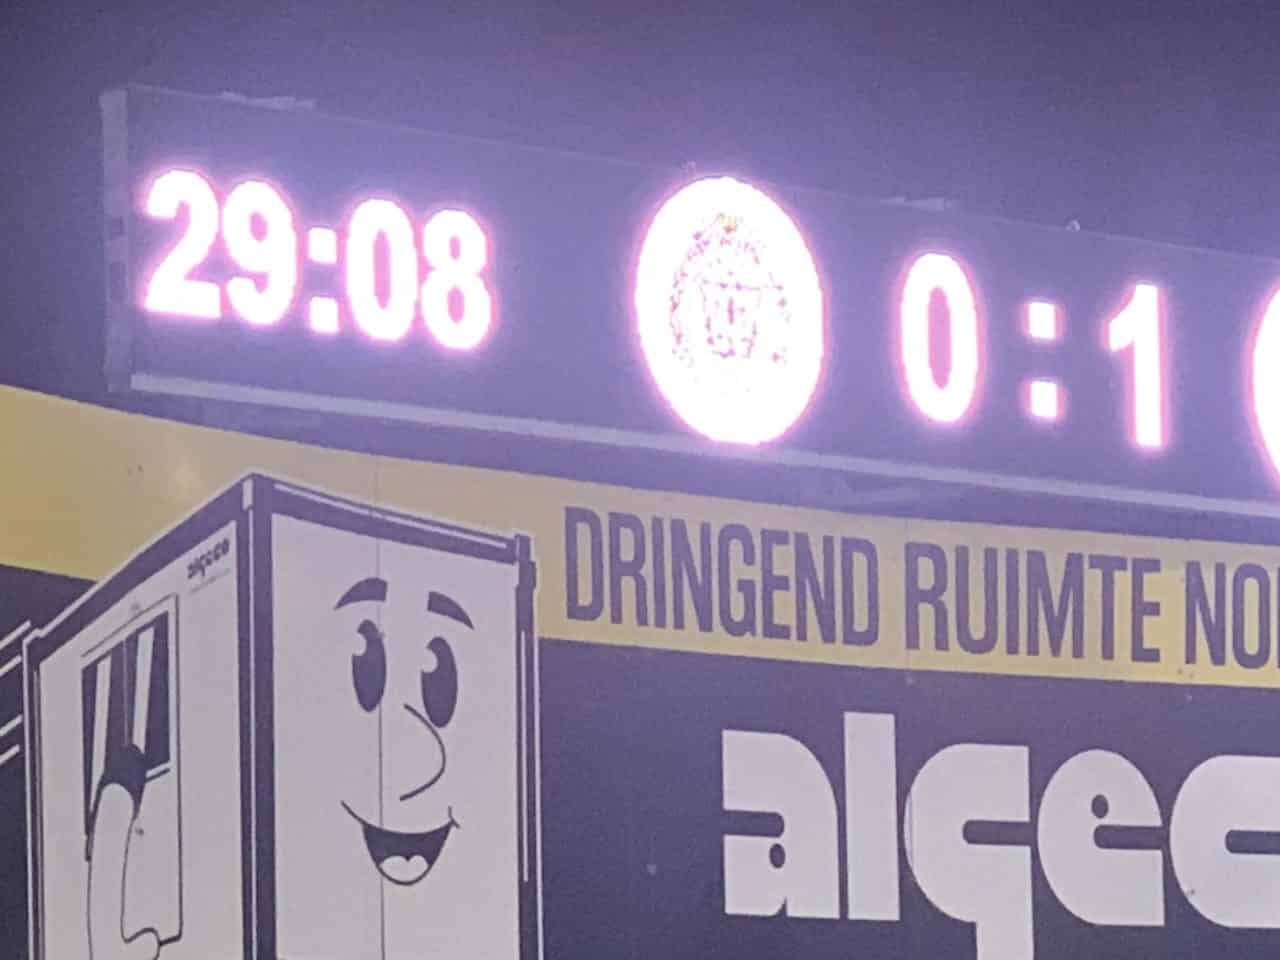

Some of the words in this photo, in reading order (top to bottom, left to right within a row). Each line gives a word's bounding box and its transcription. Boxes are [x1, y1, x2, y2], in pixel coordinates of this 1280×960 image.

[144, 169, 492, 350] 29:08
[564, 506, 879, 646] DRINGEND
[904, 541, 1162, 663] RUIMTE
